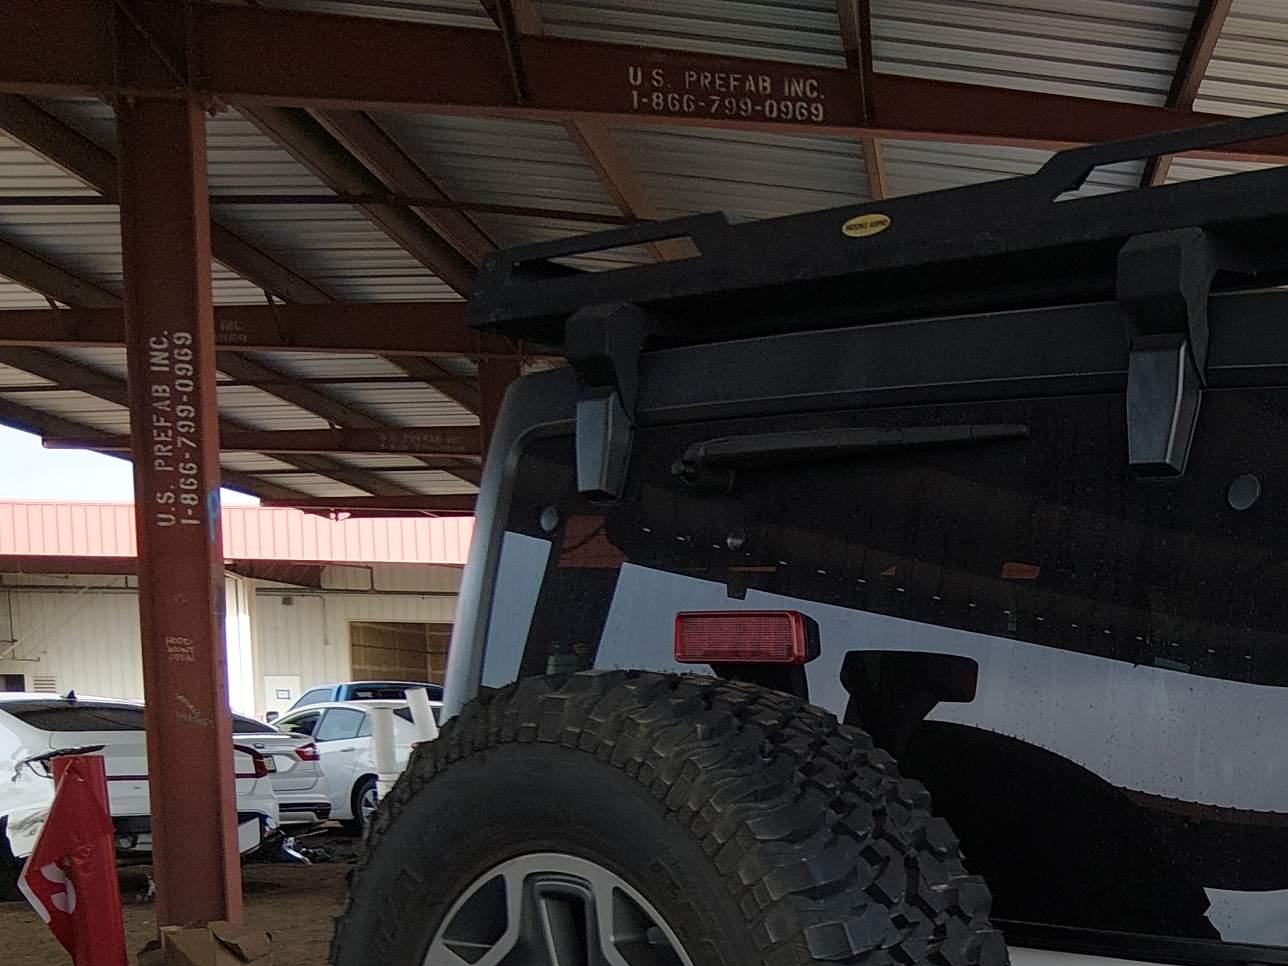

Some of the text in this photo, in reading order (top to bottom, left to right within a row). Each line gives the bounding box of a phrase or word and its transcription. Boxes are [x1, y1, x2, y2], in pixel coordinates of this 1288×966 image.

[631, 90, 825, 122] 1-866-799-0969
[684, 71, 771, 95] PREFAB
[784, 77, 825, 99] INC.
[150, 330, 176, 527] U.S. PREFAB INC.
[173, 331, 200, 525] 1-866-799-0969
